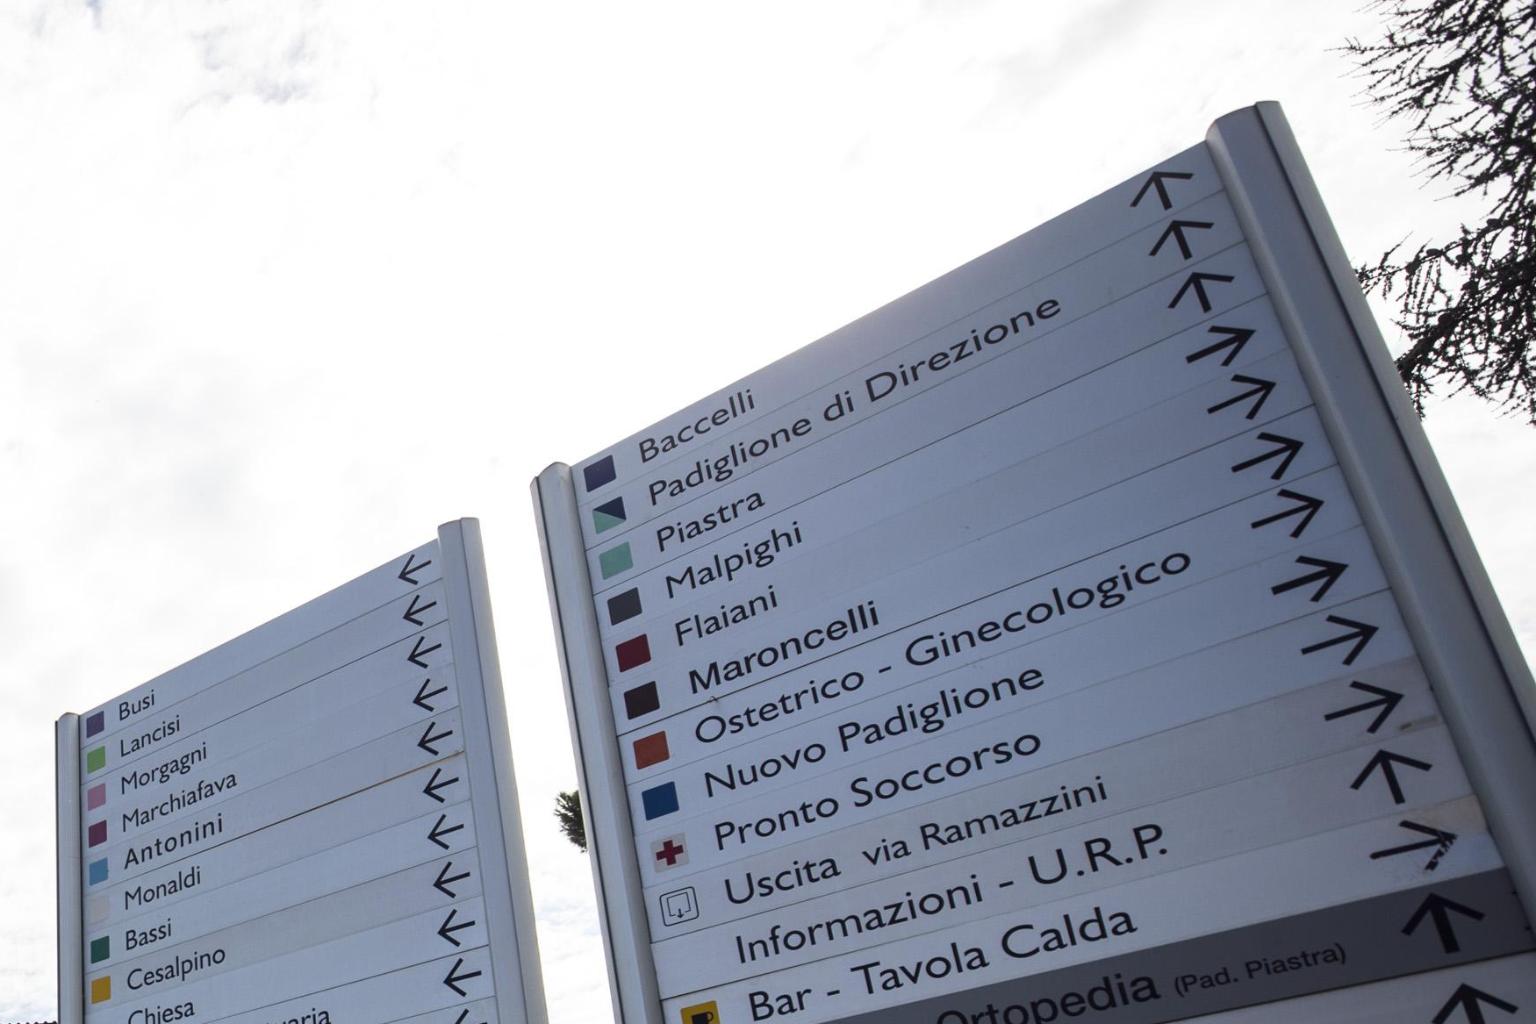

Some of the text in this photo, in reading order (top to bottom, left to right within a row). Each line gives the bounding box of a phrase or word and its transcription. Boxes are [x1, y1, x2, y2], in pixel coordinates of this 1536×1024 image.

[638, 388, 755, 464] Baccelli
[648, 298, 1062, 507] Padiglione di Direzione
[656, 492, 766, 553] Piastra
[665, 520, 802, 599] Malpighi
[674, 584, 778, 647] Flaiani
[695, 671, 865, 744] Ostetrico
[905, 550, 1193, 666] Ginecologico
[688, 600, 880, 695] Maroncelli
[118, 688, 155, 722] Busi
[120, 714, 180, 758] Lancisi
[704, 668, 1045, 798] Nuovo Padiglione
[121, 741, 207, 795] Morgagni
[714, 734, 1041, 851] Pronto Soccorso
[122, 773, 238, 833] Marchiafava
[123, 812, 223, 870] Antonini
[724, 775, 1108, 905] Uscita via Ramazzini
[124, 865, 201, 911] Monaldi
[735, 873, 983, 964] Informazioni
[1027, 823, 1168, 885] U.R.P.
[125, 917, 172, 952] Bassi
[748, 988, 813, 1022] Bar
[849, 941, 991, 995] Tavola
[1001, 906, 1139, 959] Calda
[126, 948, 226, 991] Cesalpino
[1173, 966, 1239, 999] (Pad.
[1244, 942, 1347, 980] Piastra)
